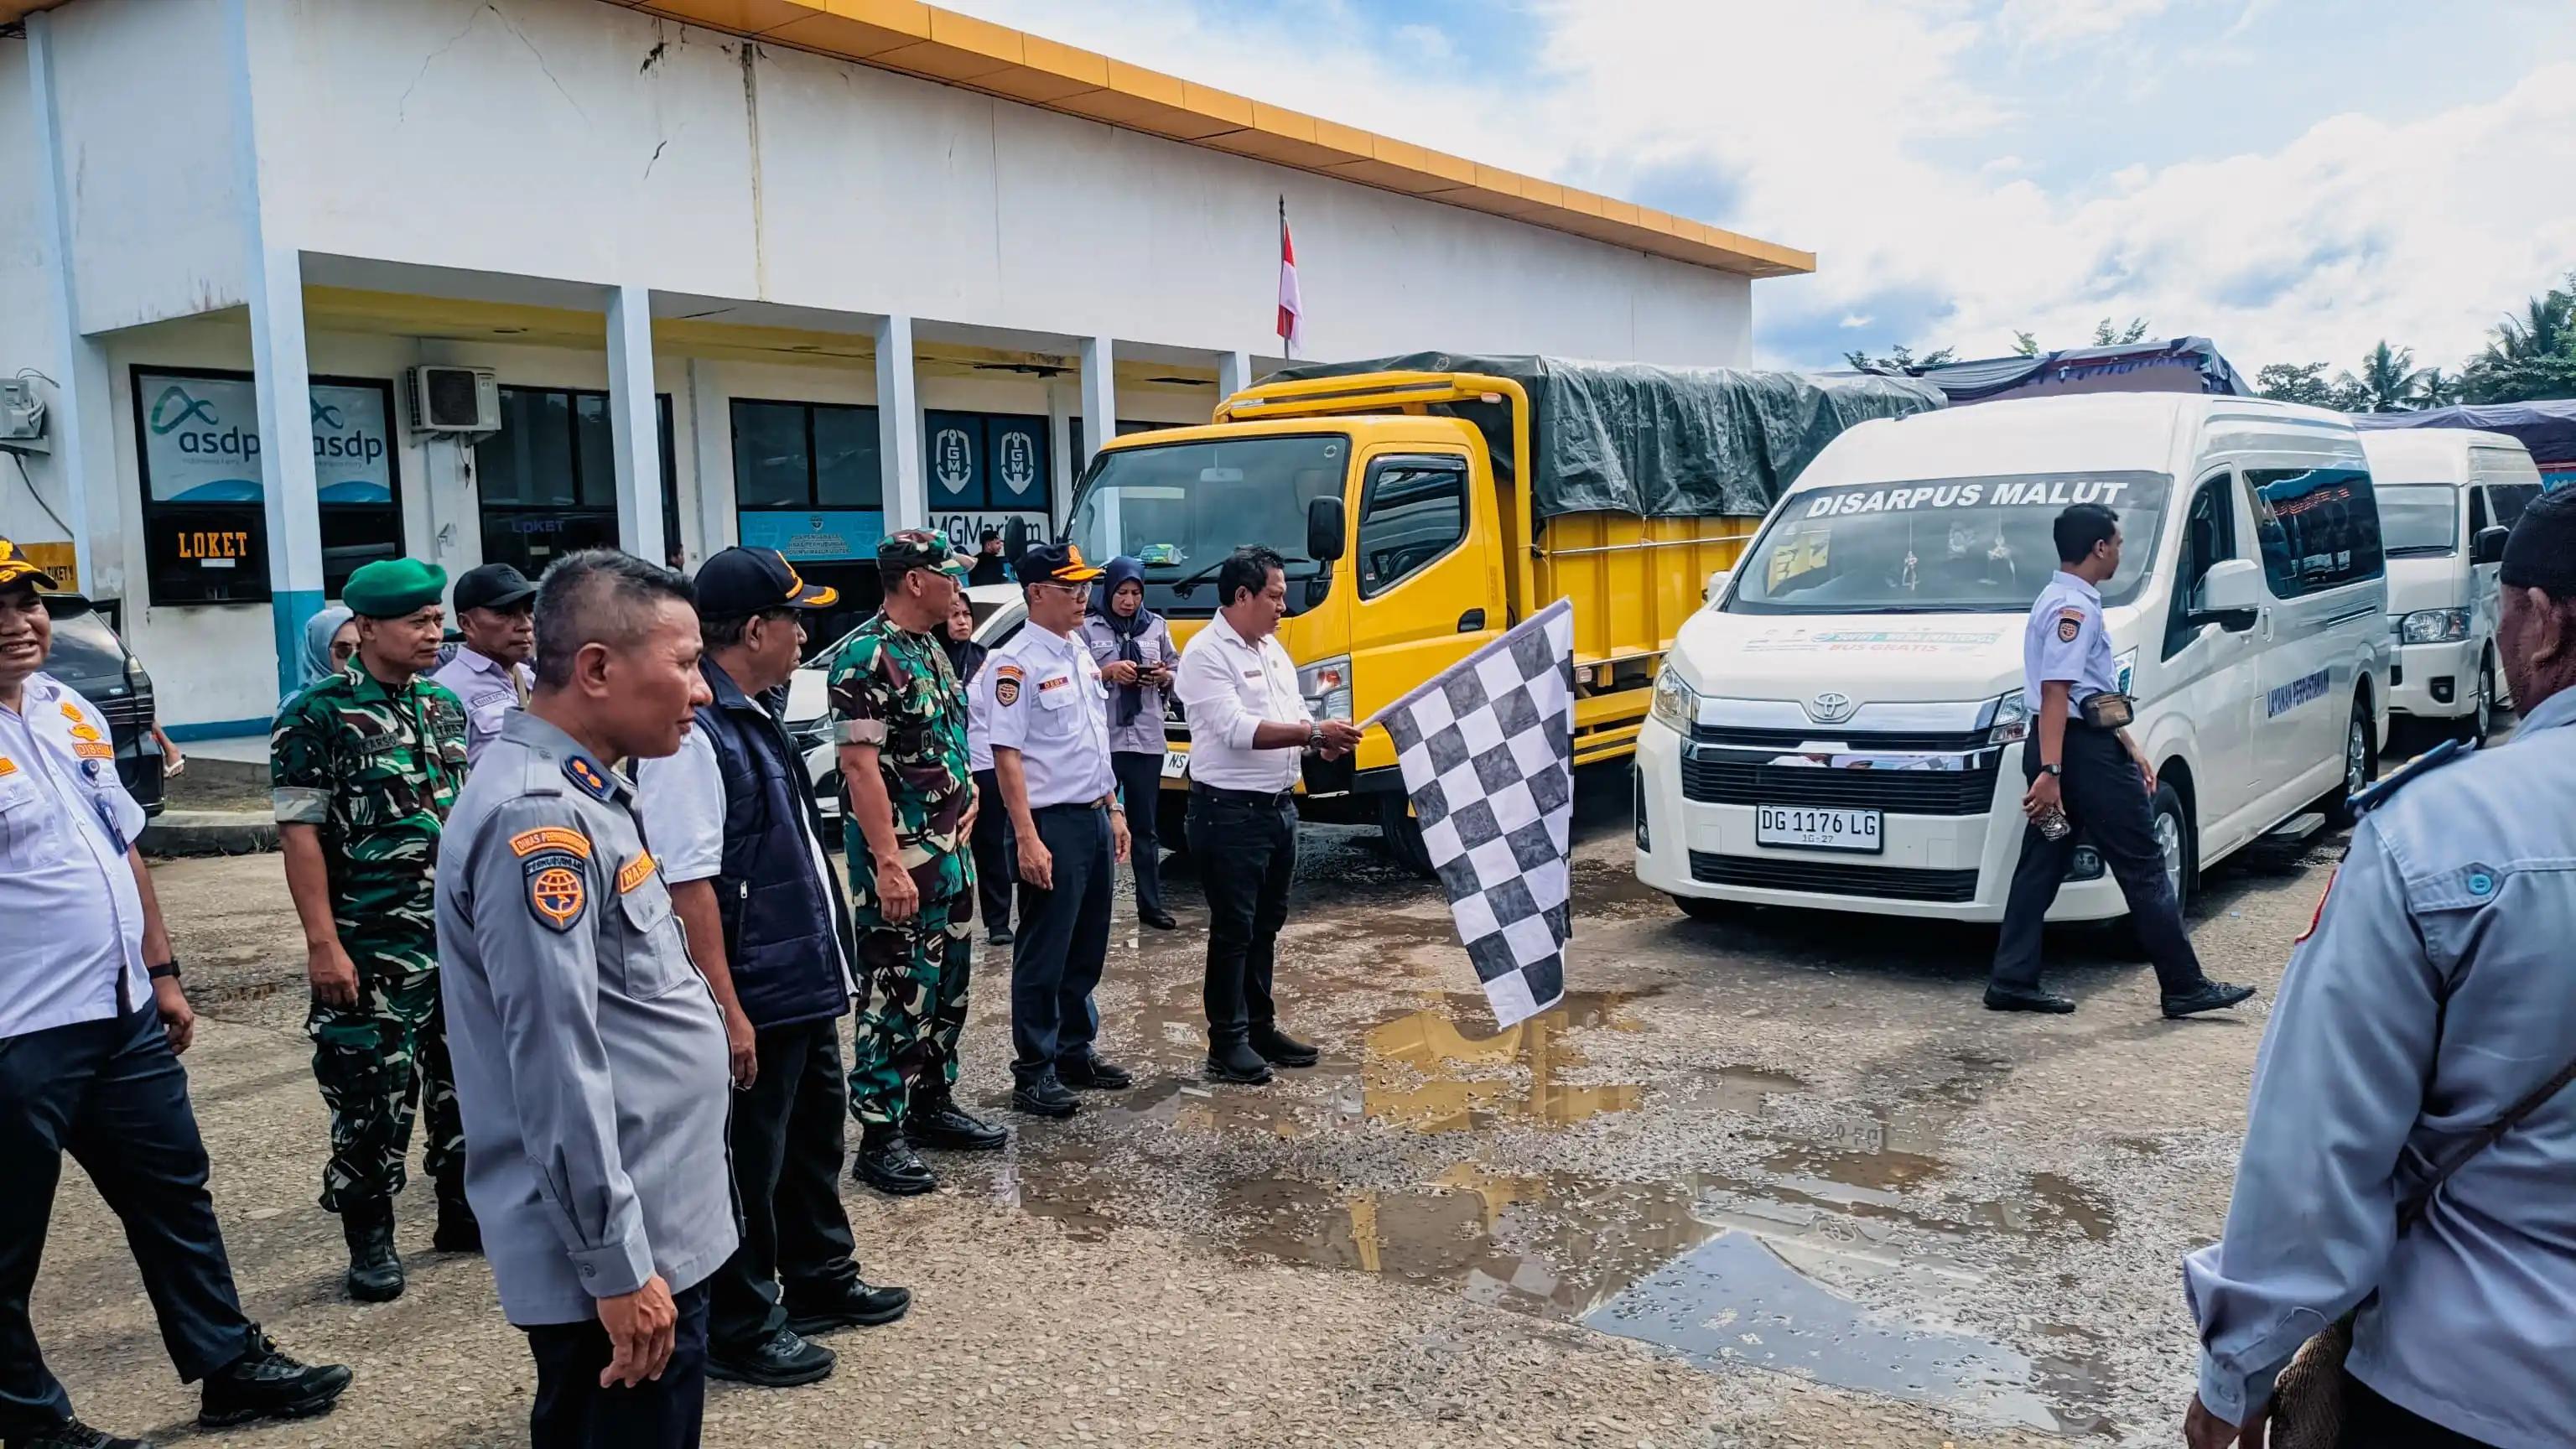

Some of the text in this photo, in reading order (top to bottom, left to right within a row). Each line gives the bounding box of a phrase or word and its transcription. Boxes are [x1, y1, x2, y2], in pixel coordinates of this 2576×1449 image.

[179, 426, 260, 462] asdp
[314, 430, 382, 465] asdp
[1806, 482, 2128, 518] DISARPUS MALUT
[511, 519, 564, 533] LOKET
[178, 532, 247, 558] LOKET
[1829, 643, 1866, 652] BUS
[1870, 643, 1940, 652] GRATIS
[2267, 682, 2293, 719] LAYANAN
[1762, 809, 1876, 835] DG 1176 LG
[517, 834, 540, 850] DINAS
